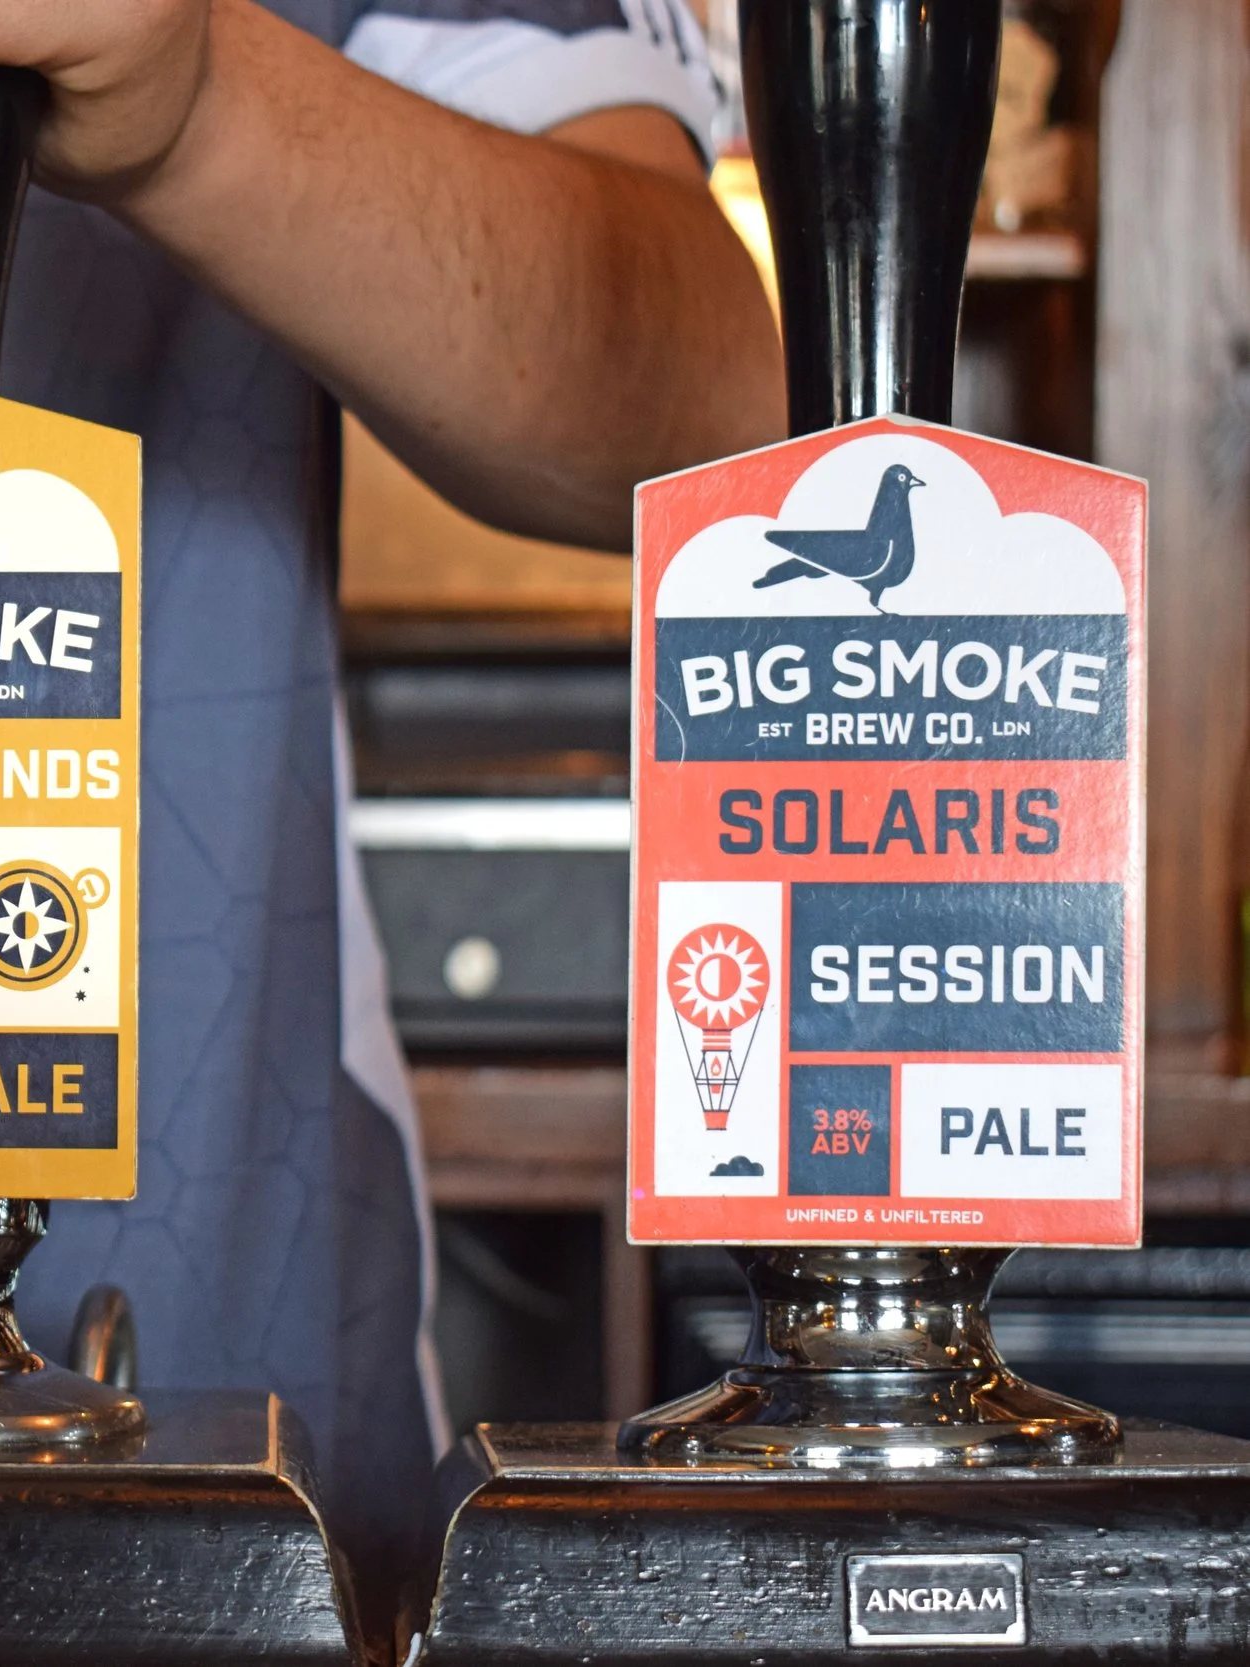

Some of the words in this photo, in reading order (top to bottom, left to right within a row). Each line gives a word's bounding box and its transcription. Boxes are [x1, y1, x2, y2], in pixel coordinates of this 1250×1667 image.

[681, 644, 811, 717] BIG
[832, 639, 1107, 714] SMOKE
[758, 722, 793, 737] EST
[806, 713, 914, 745] BREW
[925, 713, 983, 744] CO.
[992, 721, 1030, 736] LDN
[719, 788, 1060, 855] SOLARIS
[810, 944, 1104, 1003] SESSION
[813, 1109, 872, 1131] 3.8%
[940, 1107, 1086, 1156] PALE
[811, 1133, 871, 1155] ABV
[786, 1208, 859, 1223] UNFINED
[864, 1209, 875, 1223] &
[880, 1209, 984, 1225] UNFILTERED
[865, 1587, 1007, 1612] ANGRAM
